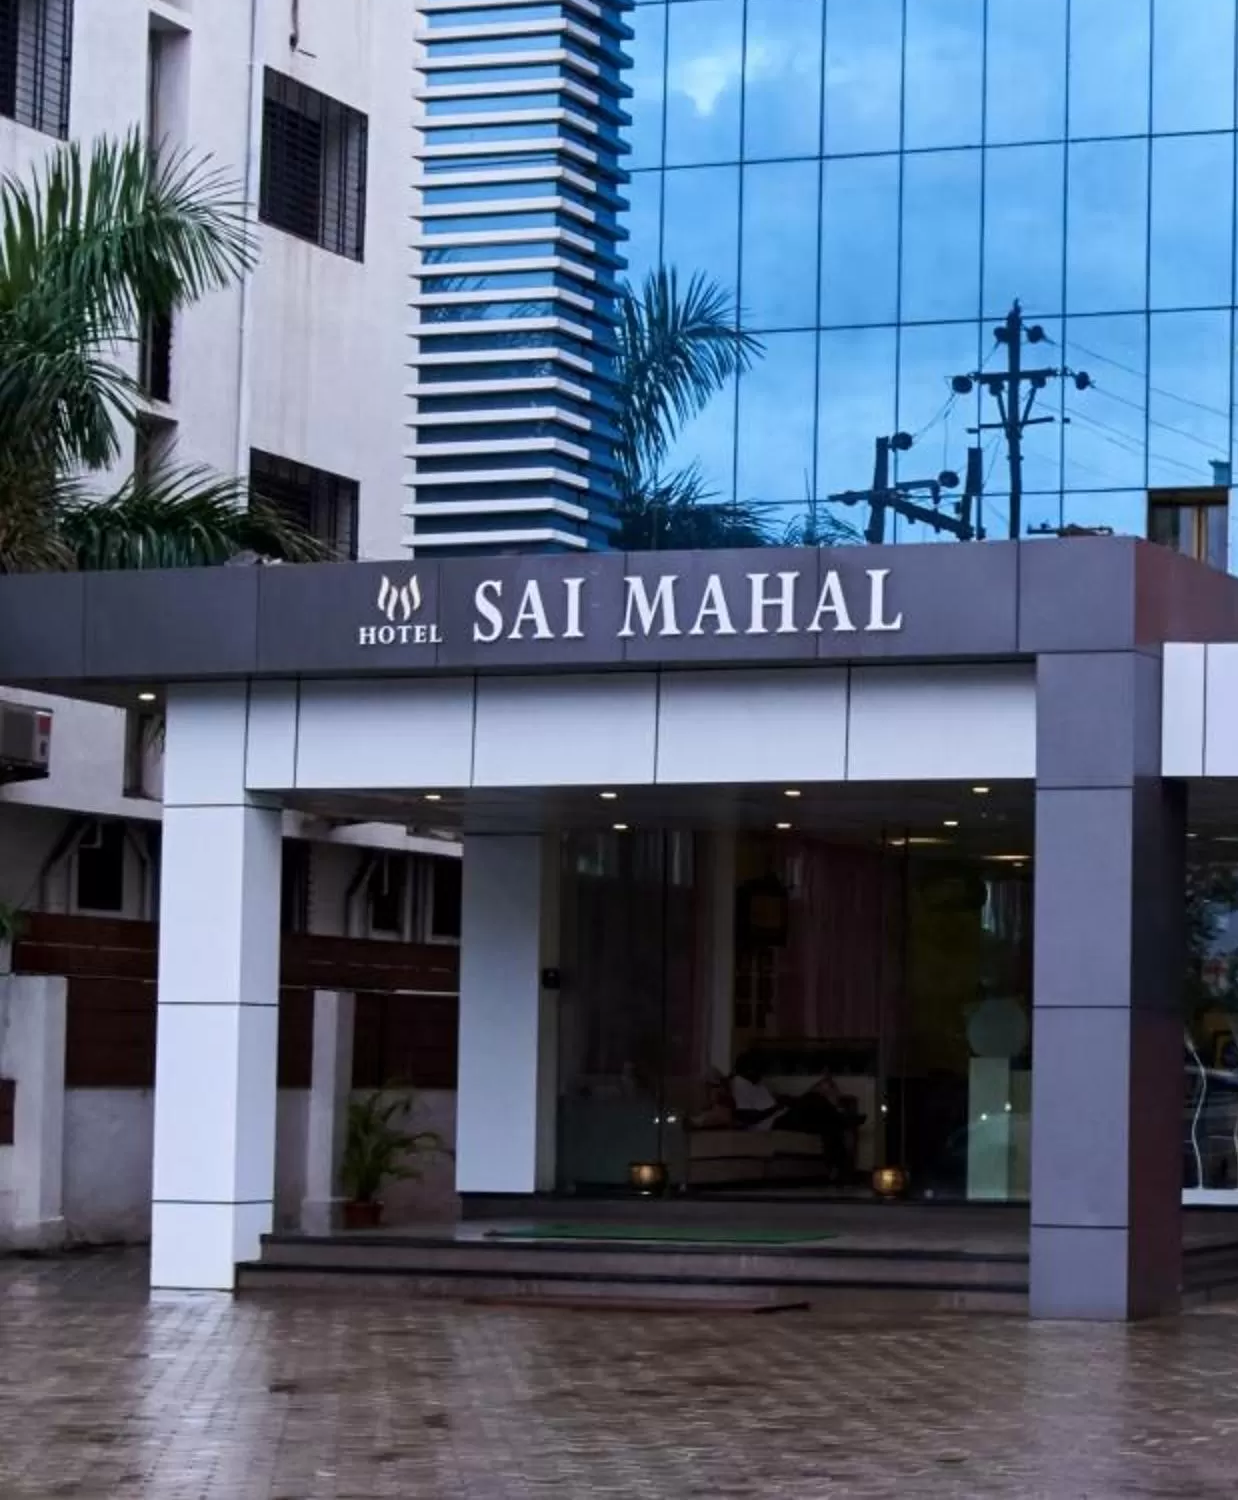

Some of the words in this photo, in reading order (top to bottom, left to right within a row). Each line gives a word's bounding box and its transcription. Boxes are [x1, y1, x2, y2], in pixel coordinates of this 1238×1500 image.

[473, 576, 586, 643] SAI
[617, 568, 902, 639] MAHAL
[358, 623, 442, 646] HOTEL
